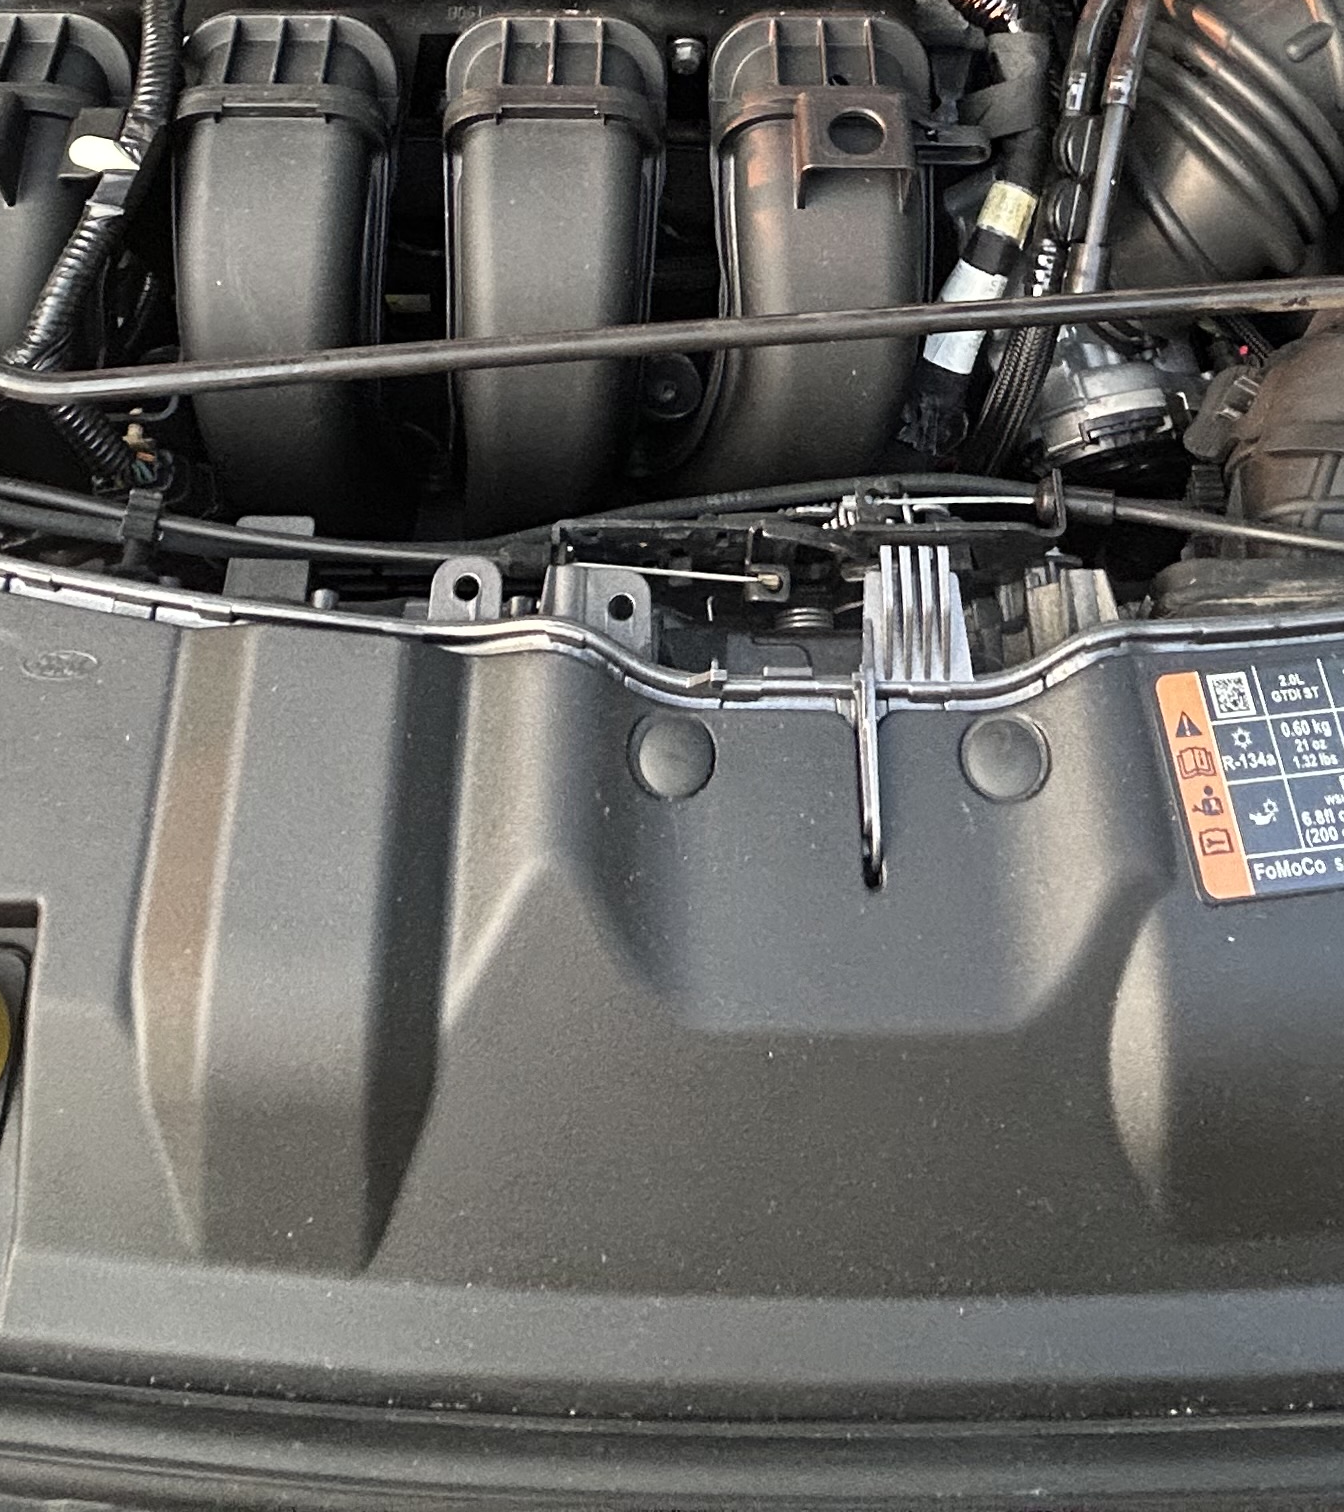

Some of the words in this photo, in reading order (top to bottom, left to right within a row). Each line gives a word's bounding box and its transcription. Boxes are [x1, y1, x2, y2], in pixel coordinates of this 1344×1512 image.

[1278, 673, 1305, 688] 2.0L
[1271, 687, 1303, 703] GTDI
[1303, 686, 1319, 699] ST
[1280, 720, 1311, 738] 0.60
[1312, 717, 1333, 738] kg
[1294, 740, 1310, 754] 21
[1312, 740, 1328, 752] oz
[1222, 752, 1277, 772] R-134a
[1292, 754, 1318, 769] 1.32
[1319, 752, 1338, 767] lbs
[1305, 827, 1339, 848] (200
[1254, 858, 1327, 881] FoMoCo
